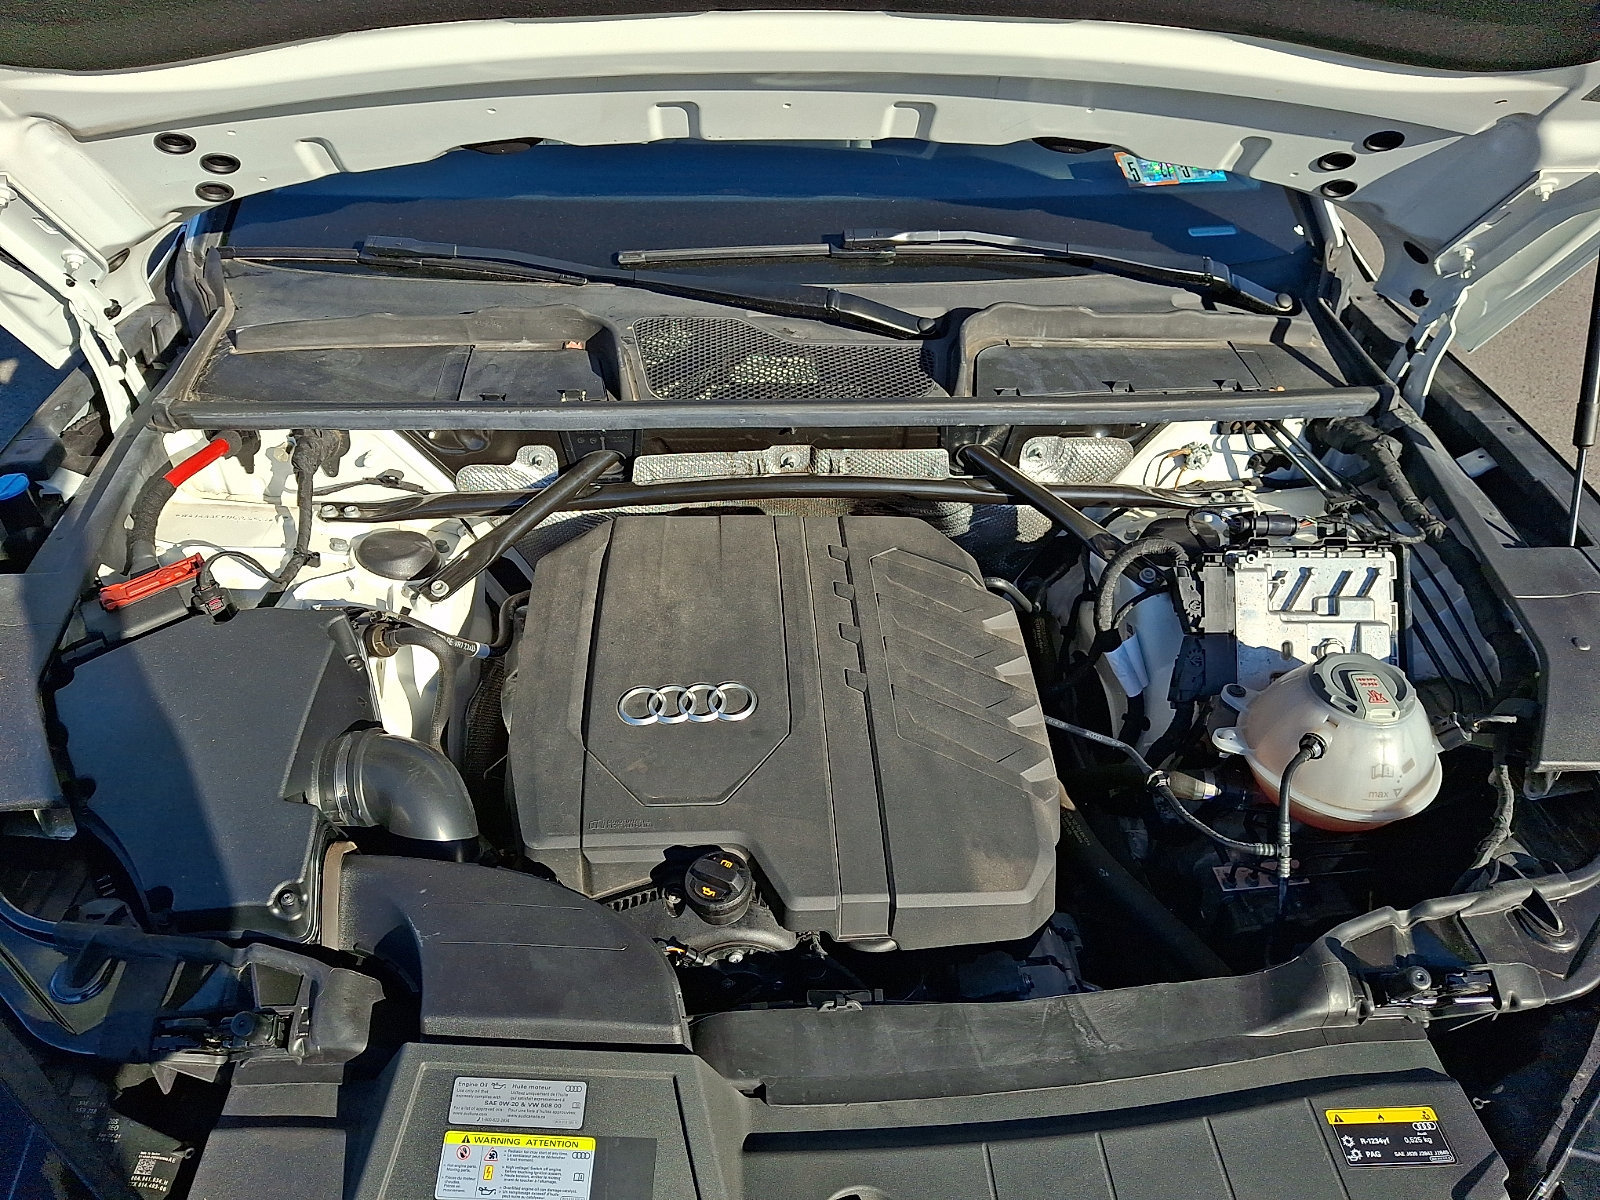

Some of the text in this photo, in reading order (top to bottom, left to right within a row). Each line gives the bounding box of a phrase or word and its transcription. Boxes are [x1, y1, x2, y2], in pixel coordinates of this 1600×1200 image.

[474, 1136, 579, 1148] WARNING ATTENTION
[1360, 1137, 1390, 1145] R-1234yf
